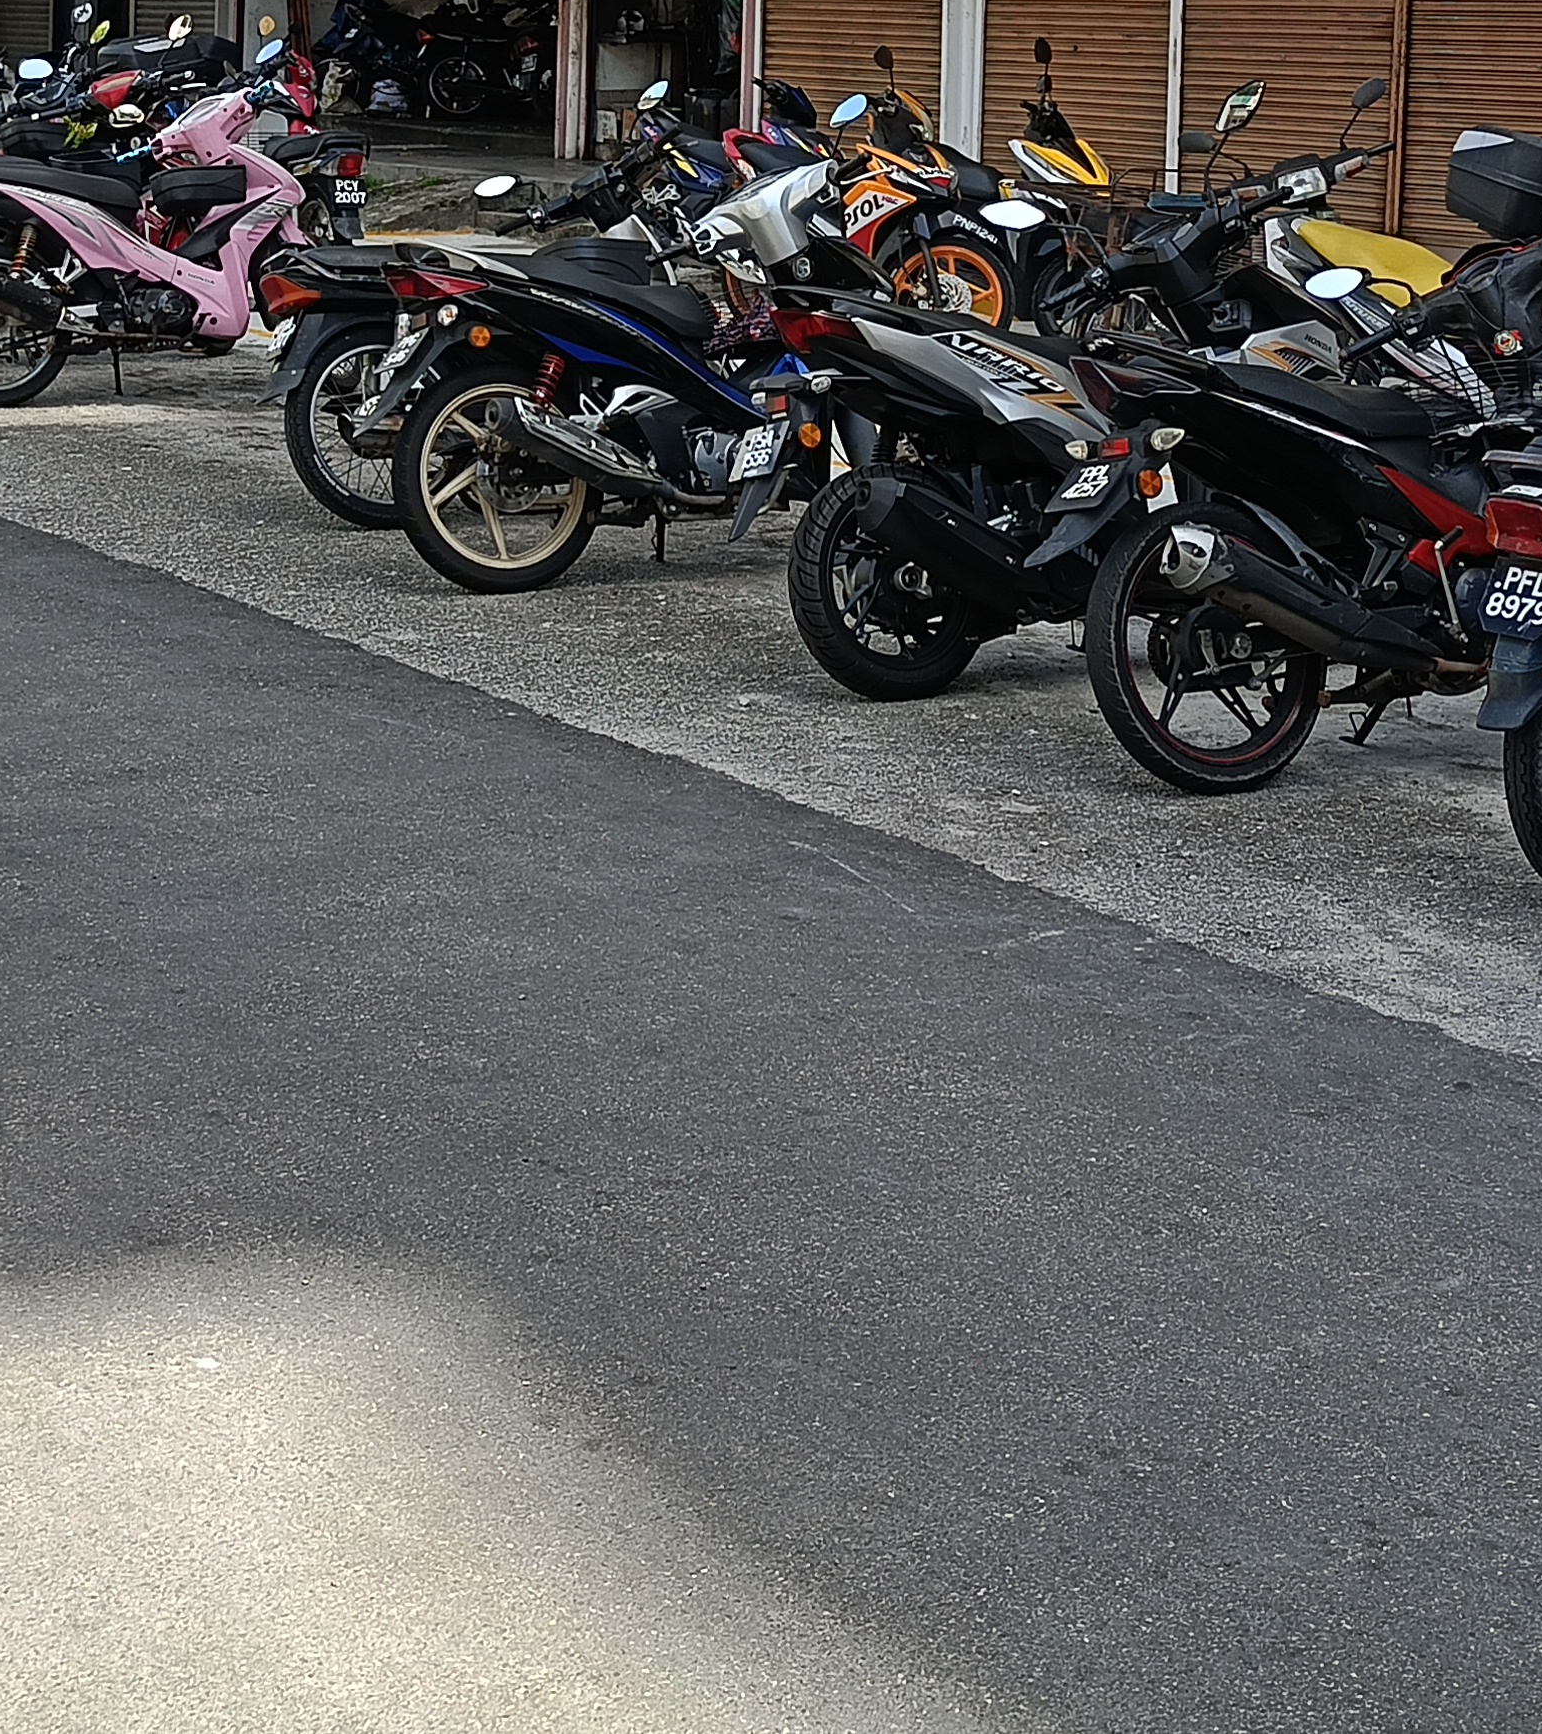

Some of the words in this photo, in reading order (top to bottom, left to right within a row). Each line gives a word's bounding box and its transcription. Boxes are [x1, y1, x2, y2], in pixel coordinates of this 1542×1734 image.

[335, 179, 359, 191] PCY
[334, 191, 366, 204] 2007
[953, 214, 998, 245] PNP1241
[1304, 334, 1332, 354] HONDA
[1080, 464, 1109, 483] PPL
